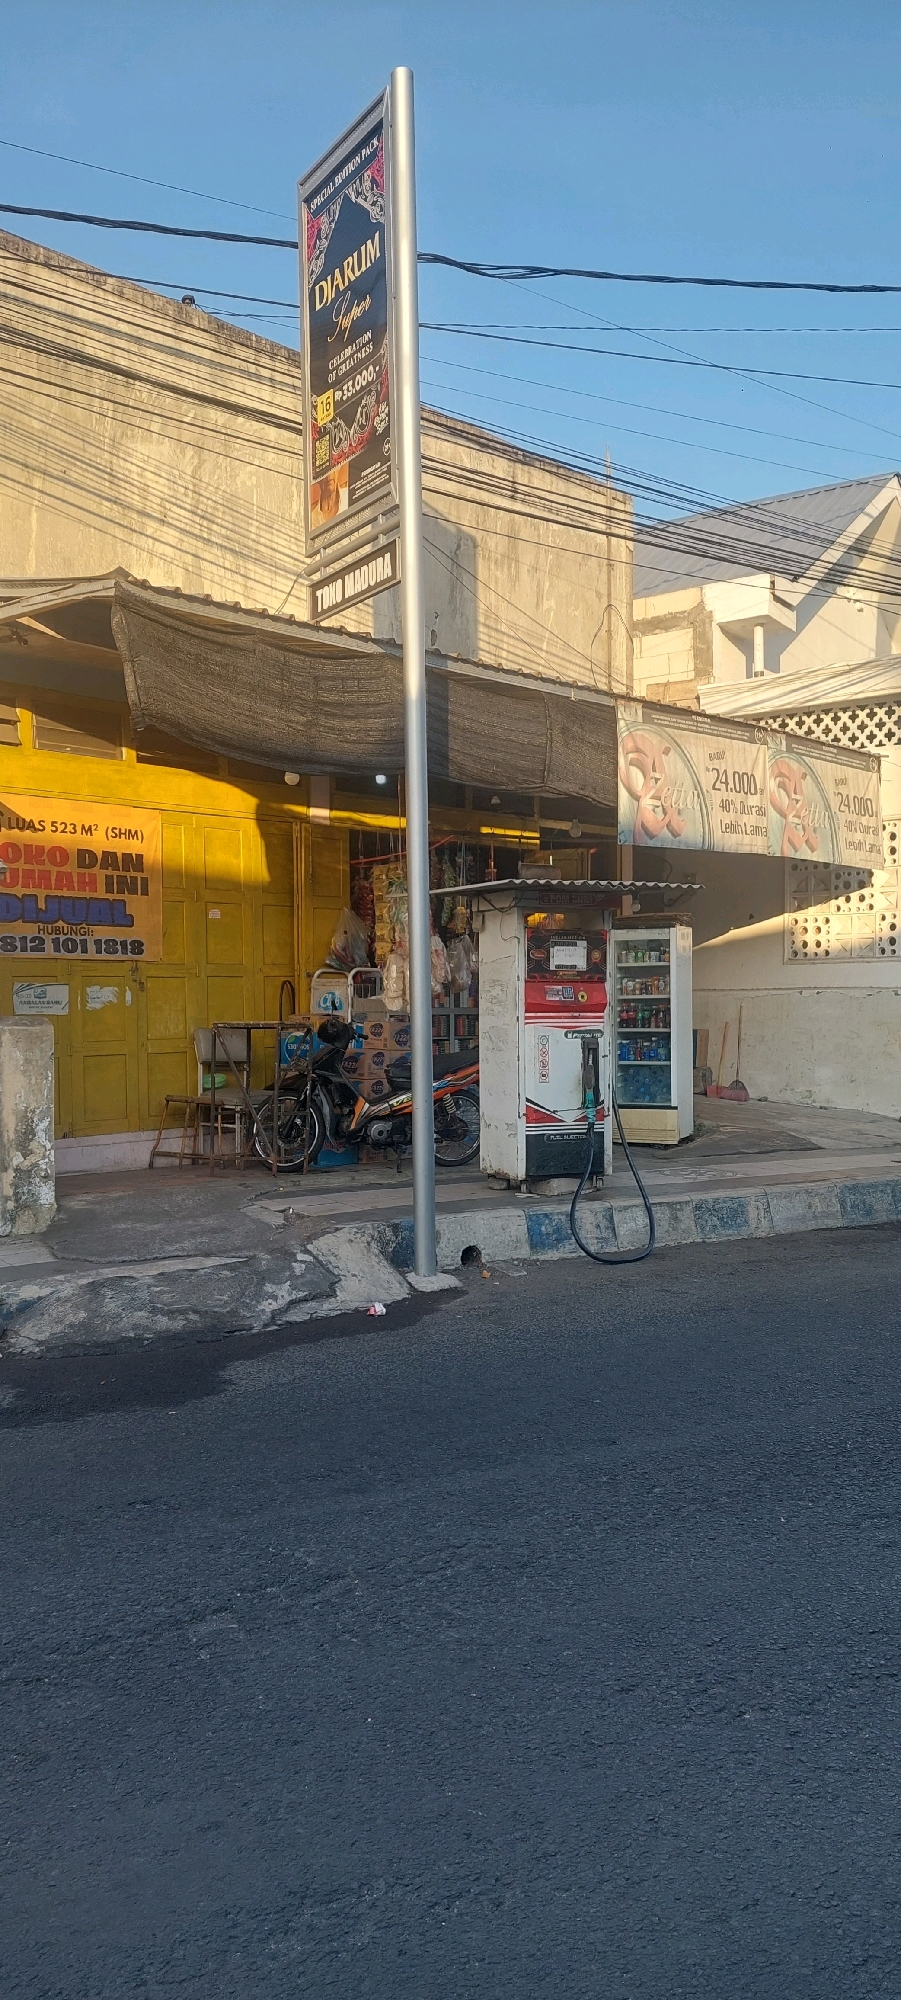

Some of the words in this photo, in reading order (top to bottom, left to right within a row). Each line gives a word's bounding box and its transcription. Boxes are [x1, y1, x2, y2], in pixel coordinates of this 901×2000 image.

[310, 182, 335, 212] SPECIAL
[334, 153, 361, 187] EDITION
[361, 134, 379, 160] PACK
[314, 230, 380, 312] DJARUM
[327, 290, 372, 342] Super
[327, 371, 336, 384] OF
[338, 341, 374, 376] GREATNESS
[328, 329, 372, 370] CELEBRATION
[320, 395, 331, 415] 16
[315, 578, 343, 613] TOKO
[344, 551, 393, 599] MADURA
[711, 767, 758, 796] 24.000
[718, 797, 739, 815] 40%
[739, 800, 767, 818] Durasi
[7, 816, 46, 833] LUAS
[50, 820, 78, 835] 523
[104, 826, 145, 844] (SHM)
[720, 818, 744, 836] Lebih
[744, 818, 768, 838] Lama
[843, 818, 858, 834] 40%
[76, 848, 145, 873] DAN
[104, 873, 150, 897] INI
[0, 892, 135, 928] DIJUAL
[37, 924, 94, 937] HUBUNGI:
[51, 936, 89, 955] 101
[93, 938, 145, 956] 1818
